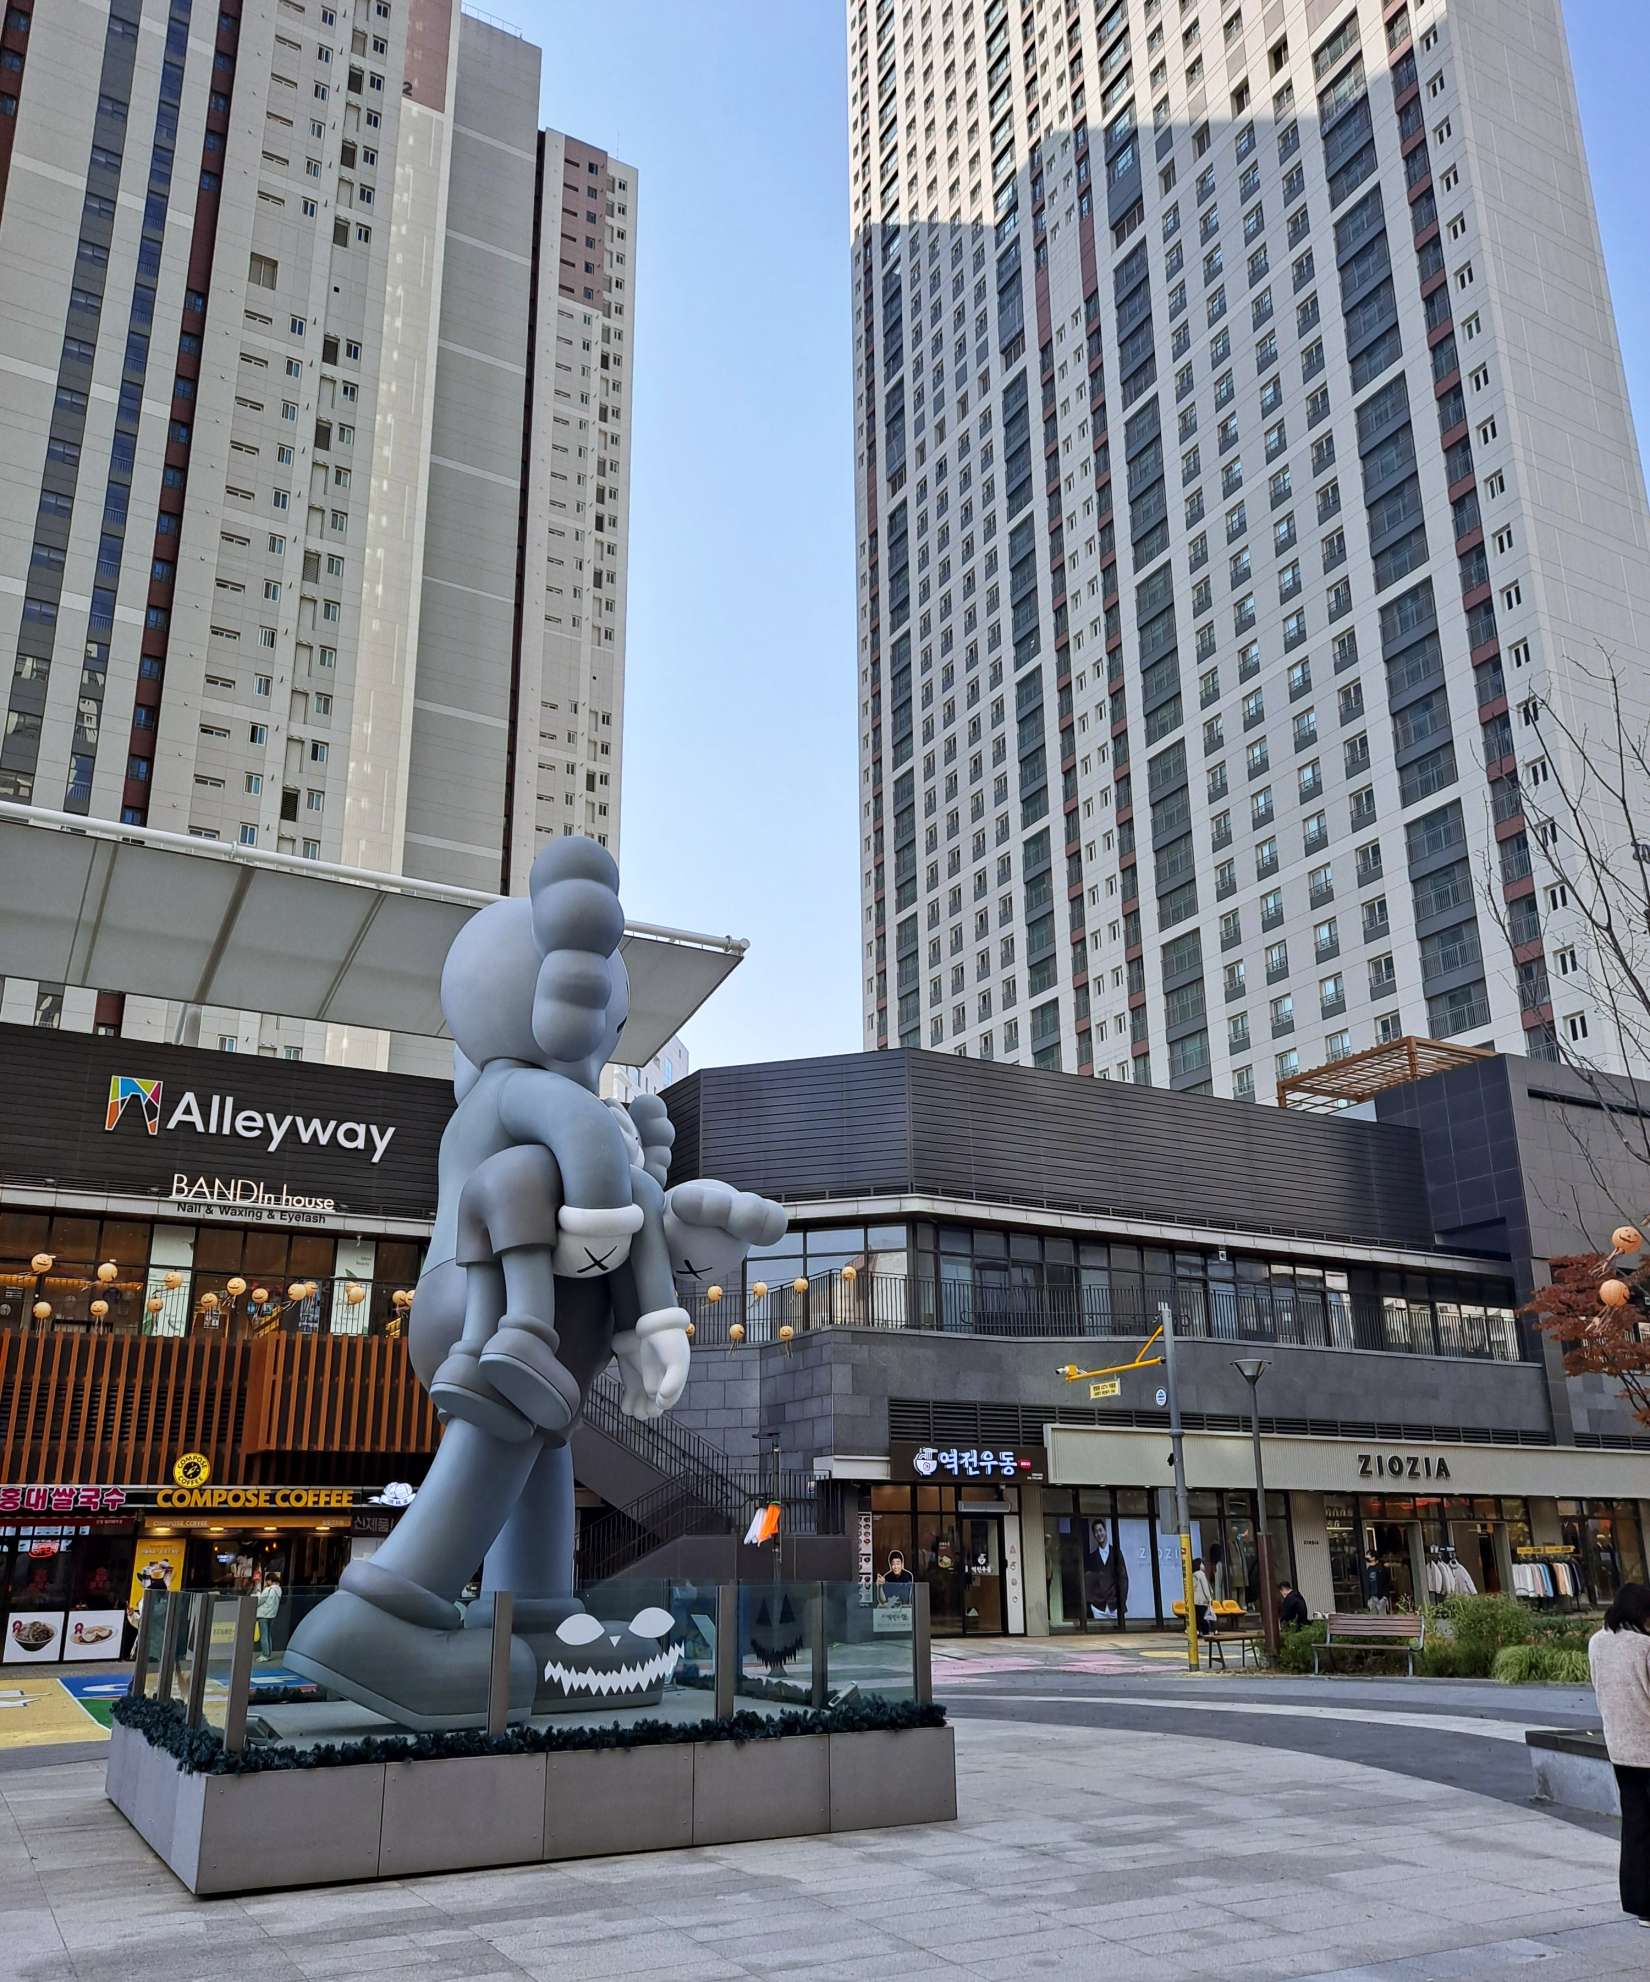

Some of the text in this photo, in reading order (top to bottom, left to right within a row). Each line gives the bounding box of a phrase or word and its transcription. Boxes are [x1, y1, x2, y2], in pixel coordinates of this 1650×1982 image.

[166, 1091, 396, 1163] Alleyway
[282, 1184, 335, 1210] house
[177, 1203, 326, 1224] Nail & Waxing & Eyelash
[177, 1455, 208, 1469] COMPOSE
[938, 1448, 1018, 1476] 역전우동
[1357, 1453, 1451, 1480] ZIOZIA
[178, 1475, 204, 1486] COFFEE
[0, 1486, 126, 1511] 홍대쌀국수
[156, 1489, 353, 1508] COMPOSE COFFEE
